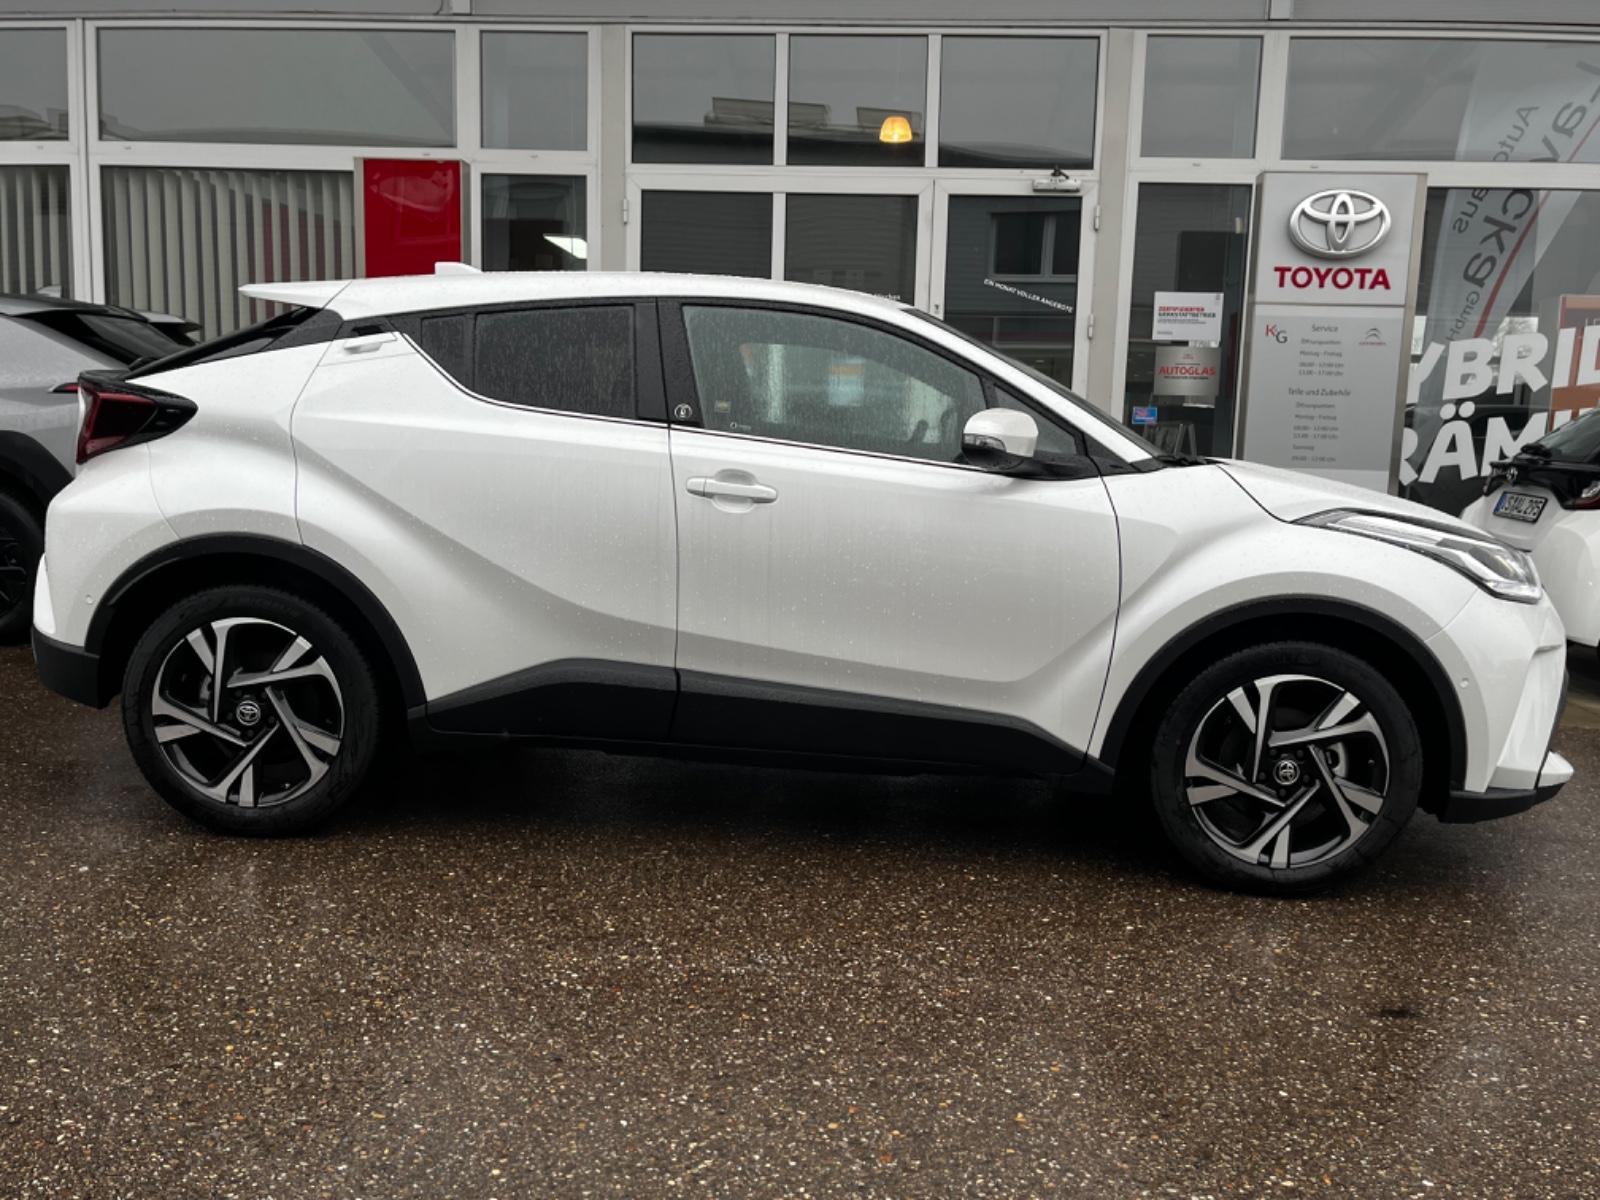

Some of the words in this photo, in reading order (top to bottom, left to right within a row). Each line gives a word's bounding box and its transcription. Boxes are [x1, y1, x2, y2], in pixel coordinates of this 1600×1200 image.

[1274, 266, 1391, 290] TOYOTA
[1016, 289, 1041, 302] VOLLER
[1040, 297, 1073, 314] ANGEBOTE
[1312, 324, 1338, 333] Service
[1158, 366, 1216, 376] AUTOGLAS
[1288, 387, 1304, 396] Teile
[1305, 388, 1320, 396] und
[1320, 388, 1351, 397] Zubehör
